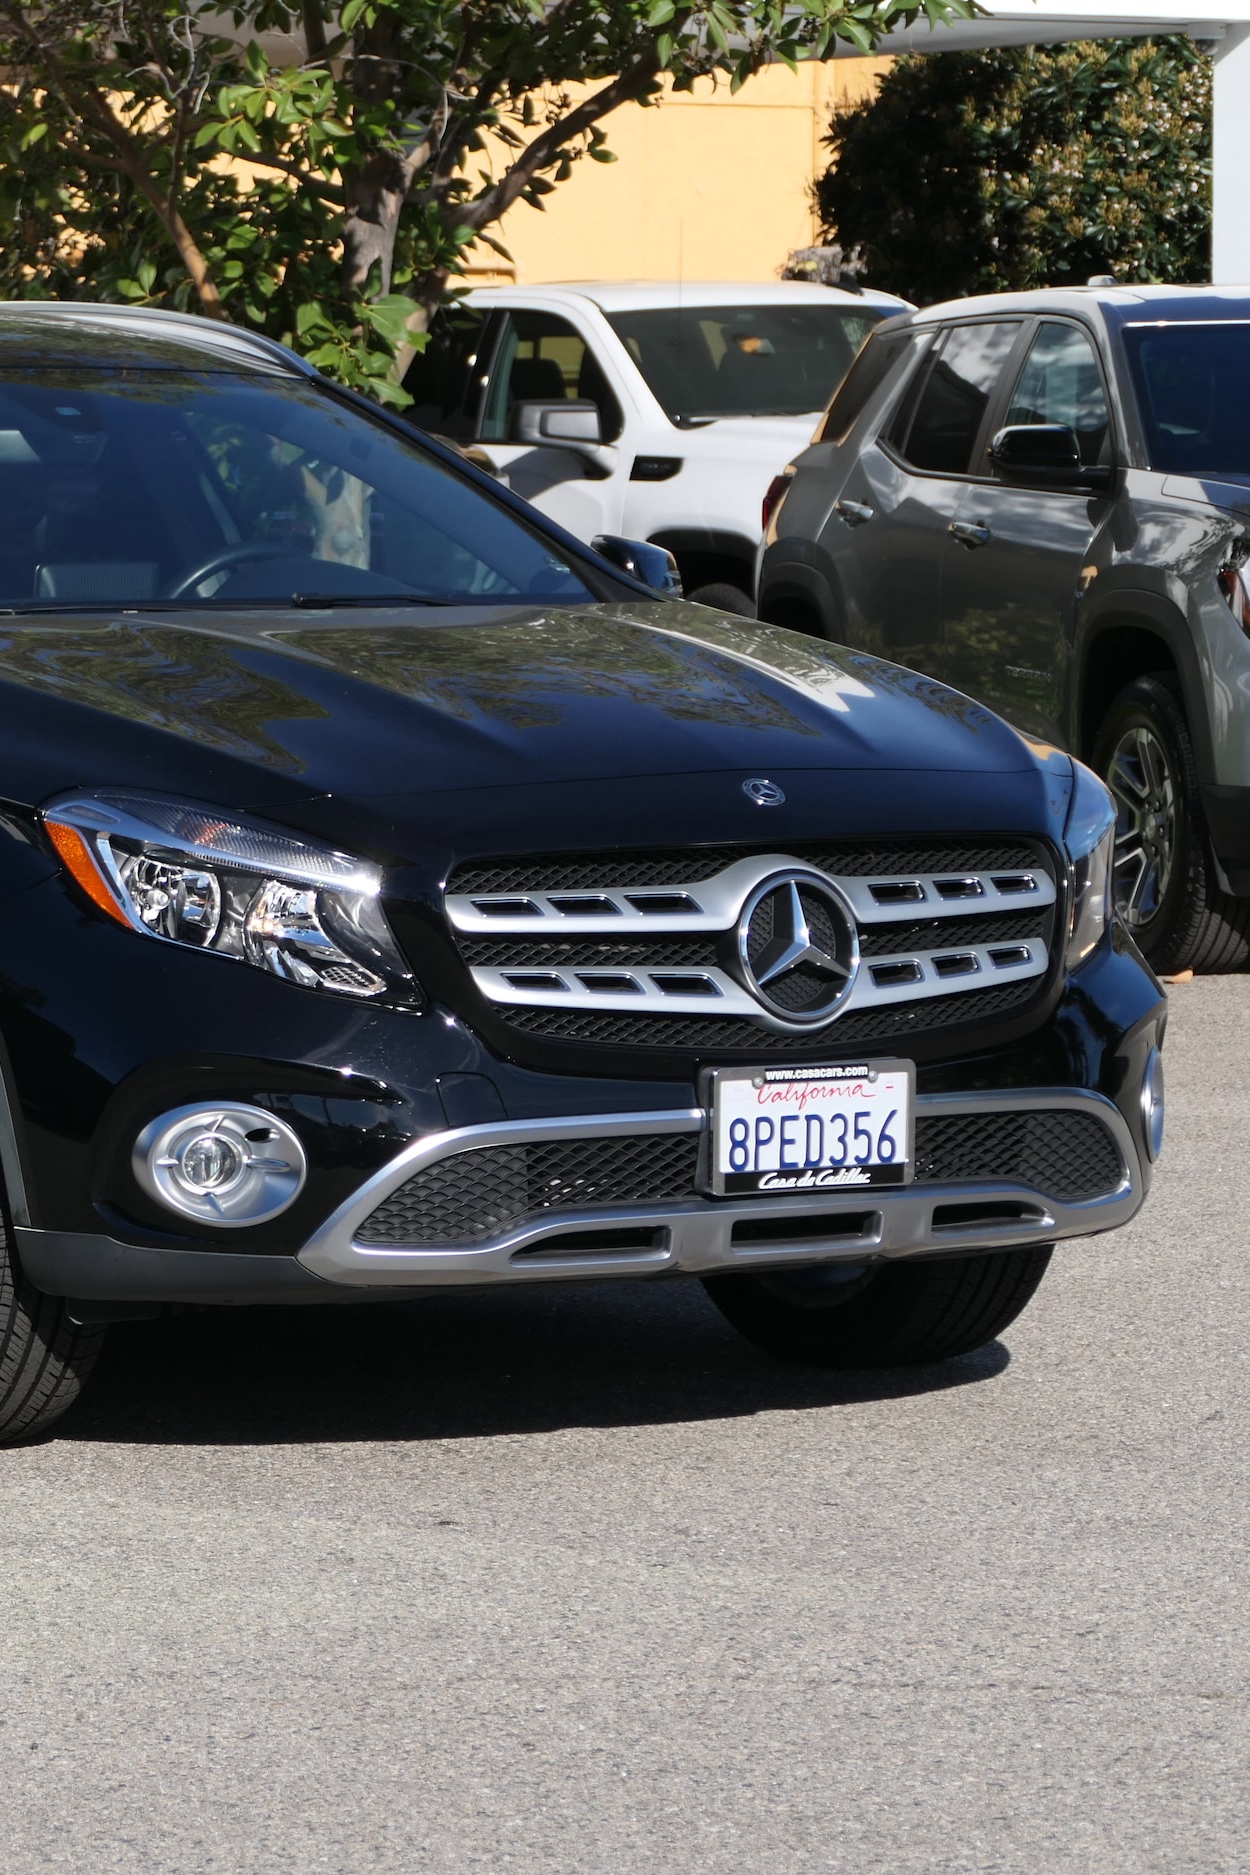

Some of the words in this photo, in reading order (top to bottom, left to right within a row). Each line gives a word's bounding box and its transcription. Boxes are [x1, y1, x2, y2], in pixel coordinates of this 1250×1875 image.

[765, 1065, 868, 1081] www.casacars.com
[757, 1083, 876, 1111] California
[729, 1109, 898, 1172] 8PED356
[758, 1171, 797, 1190] Casa
[797, 1169, 816, 1187] de
[815, 1166, 872, 1186] Cadillac
